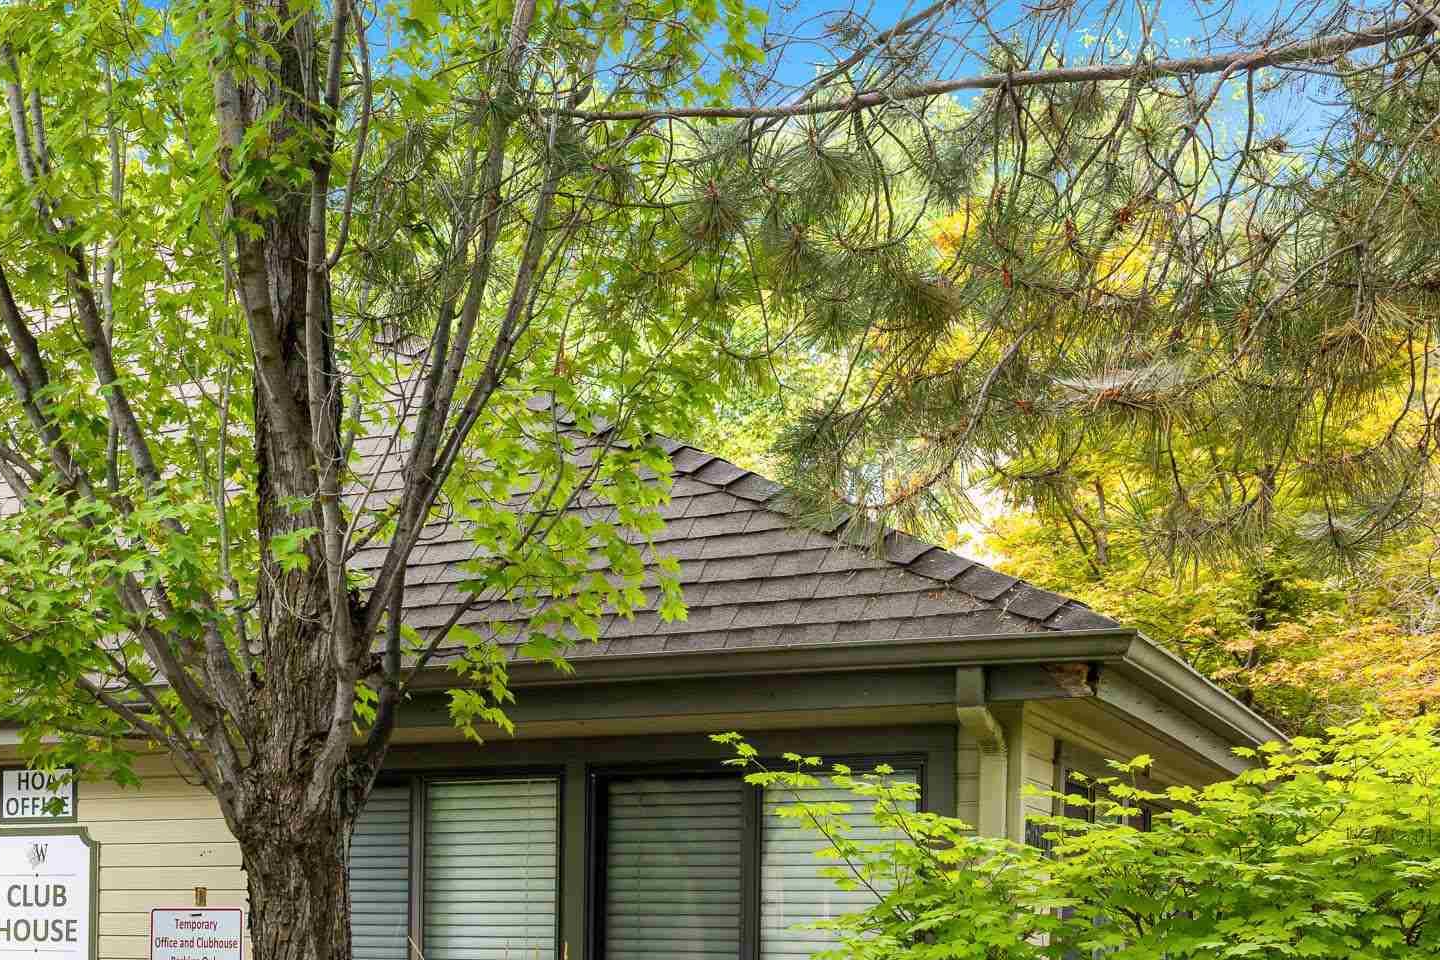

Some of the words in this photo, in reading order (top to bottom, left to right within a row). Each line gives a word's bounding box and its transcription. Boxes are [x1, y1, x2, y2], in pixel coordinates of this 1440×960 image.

[6, 796, 69, 816] OFFIE
[7, 884, 67, 908] CLUB
[175, 918, 218, 931] Temporary
[154, 937, 178, 949] Office
[180, 938, 195, 949] and
[197, 937, 239, 949] Clubhouse
